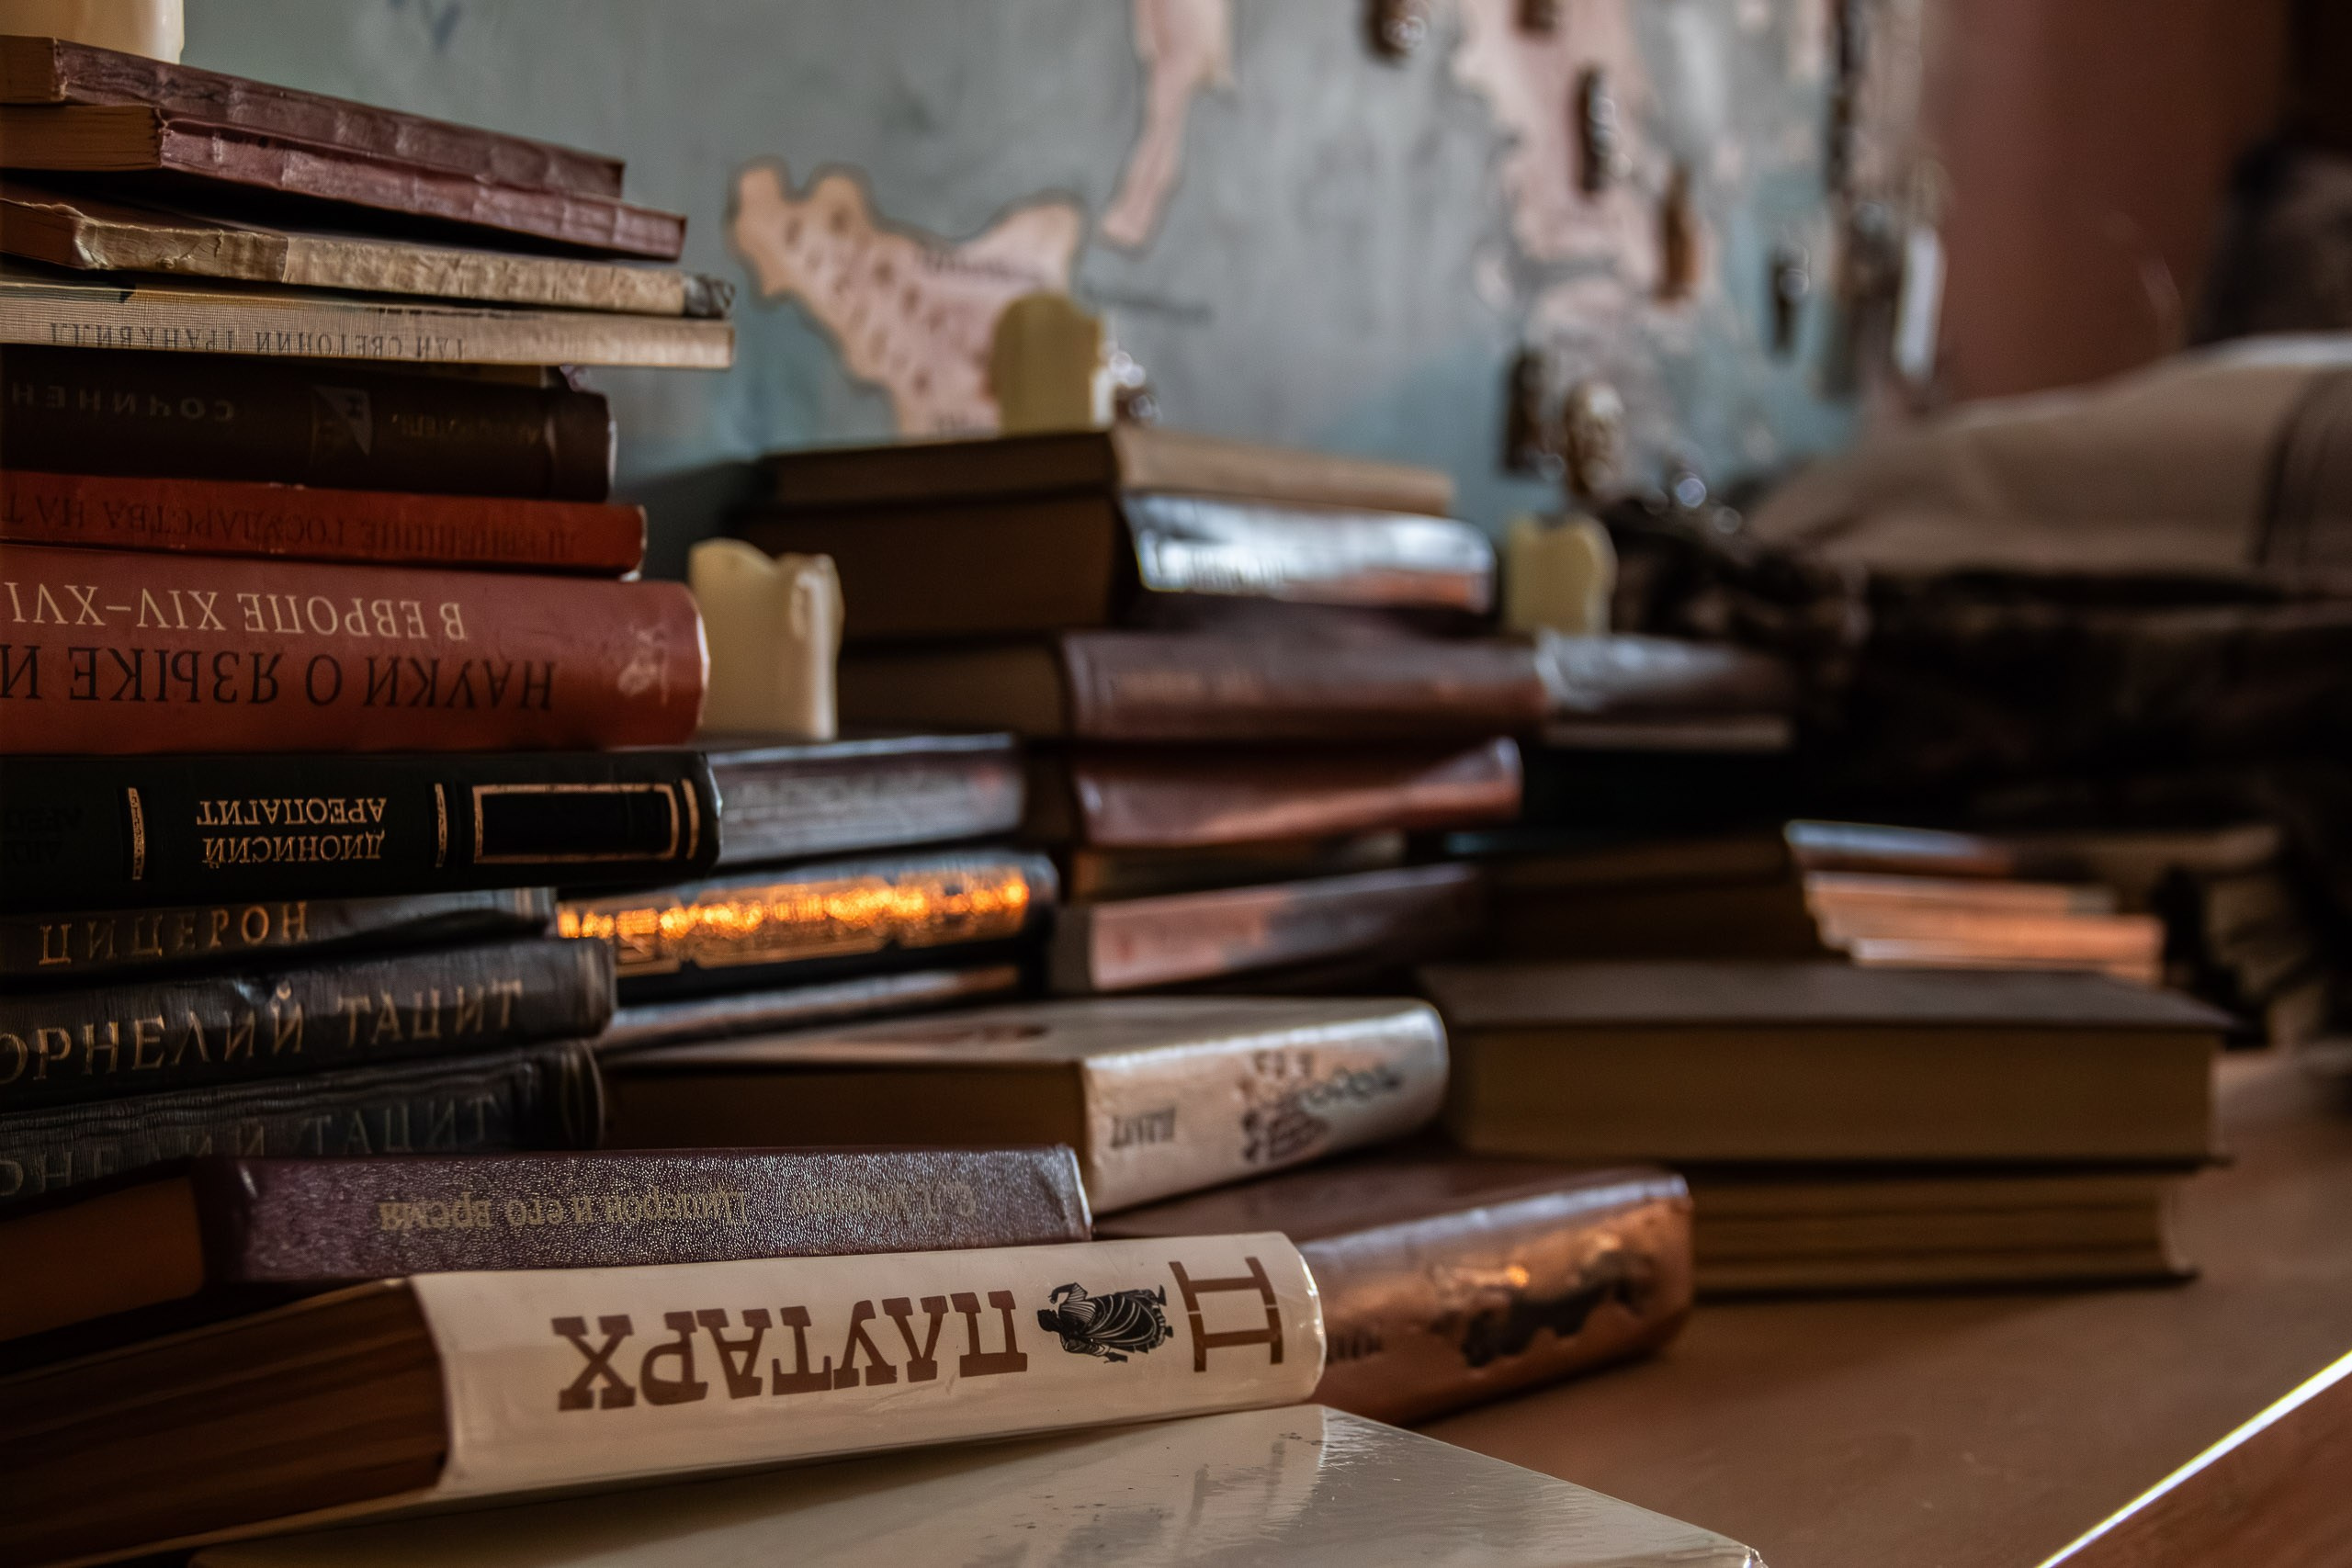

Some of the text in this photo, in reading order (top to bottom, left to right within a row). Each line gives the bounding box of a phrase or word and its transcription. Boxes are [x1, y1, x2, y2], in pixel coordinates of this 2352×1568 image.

[237, 592, 430, 641] ЕВРОПЕ
[439, 600, 469, 642] В
[0, 645, 558, 712] НАУКИ О ЯЗЫКЕ И
[196, 797, 388, 826] АРЕОПАГИТ
[201, 829, 385, 870] ДИОНИСИЙ
[38, 901, 309, 966] ЦИЦЕРОН
[337, 978, 524, 1048] ТАЦИТ
[379, 1191, 494, 1232] время
[505, 1198, 561, 1226] его
[599, 1182, 748, 1225] Цицерон
[551, 1290, 1029, 1412] ПЛУТАРХ
